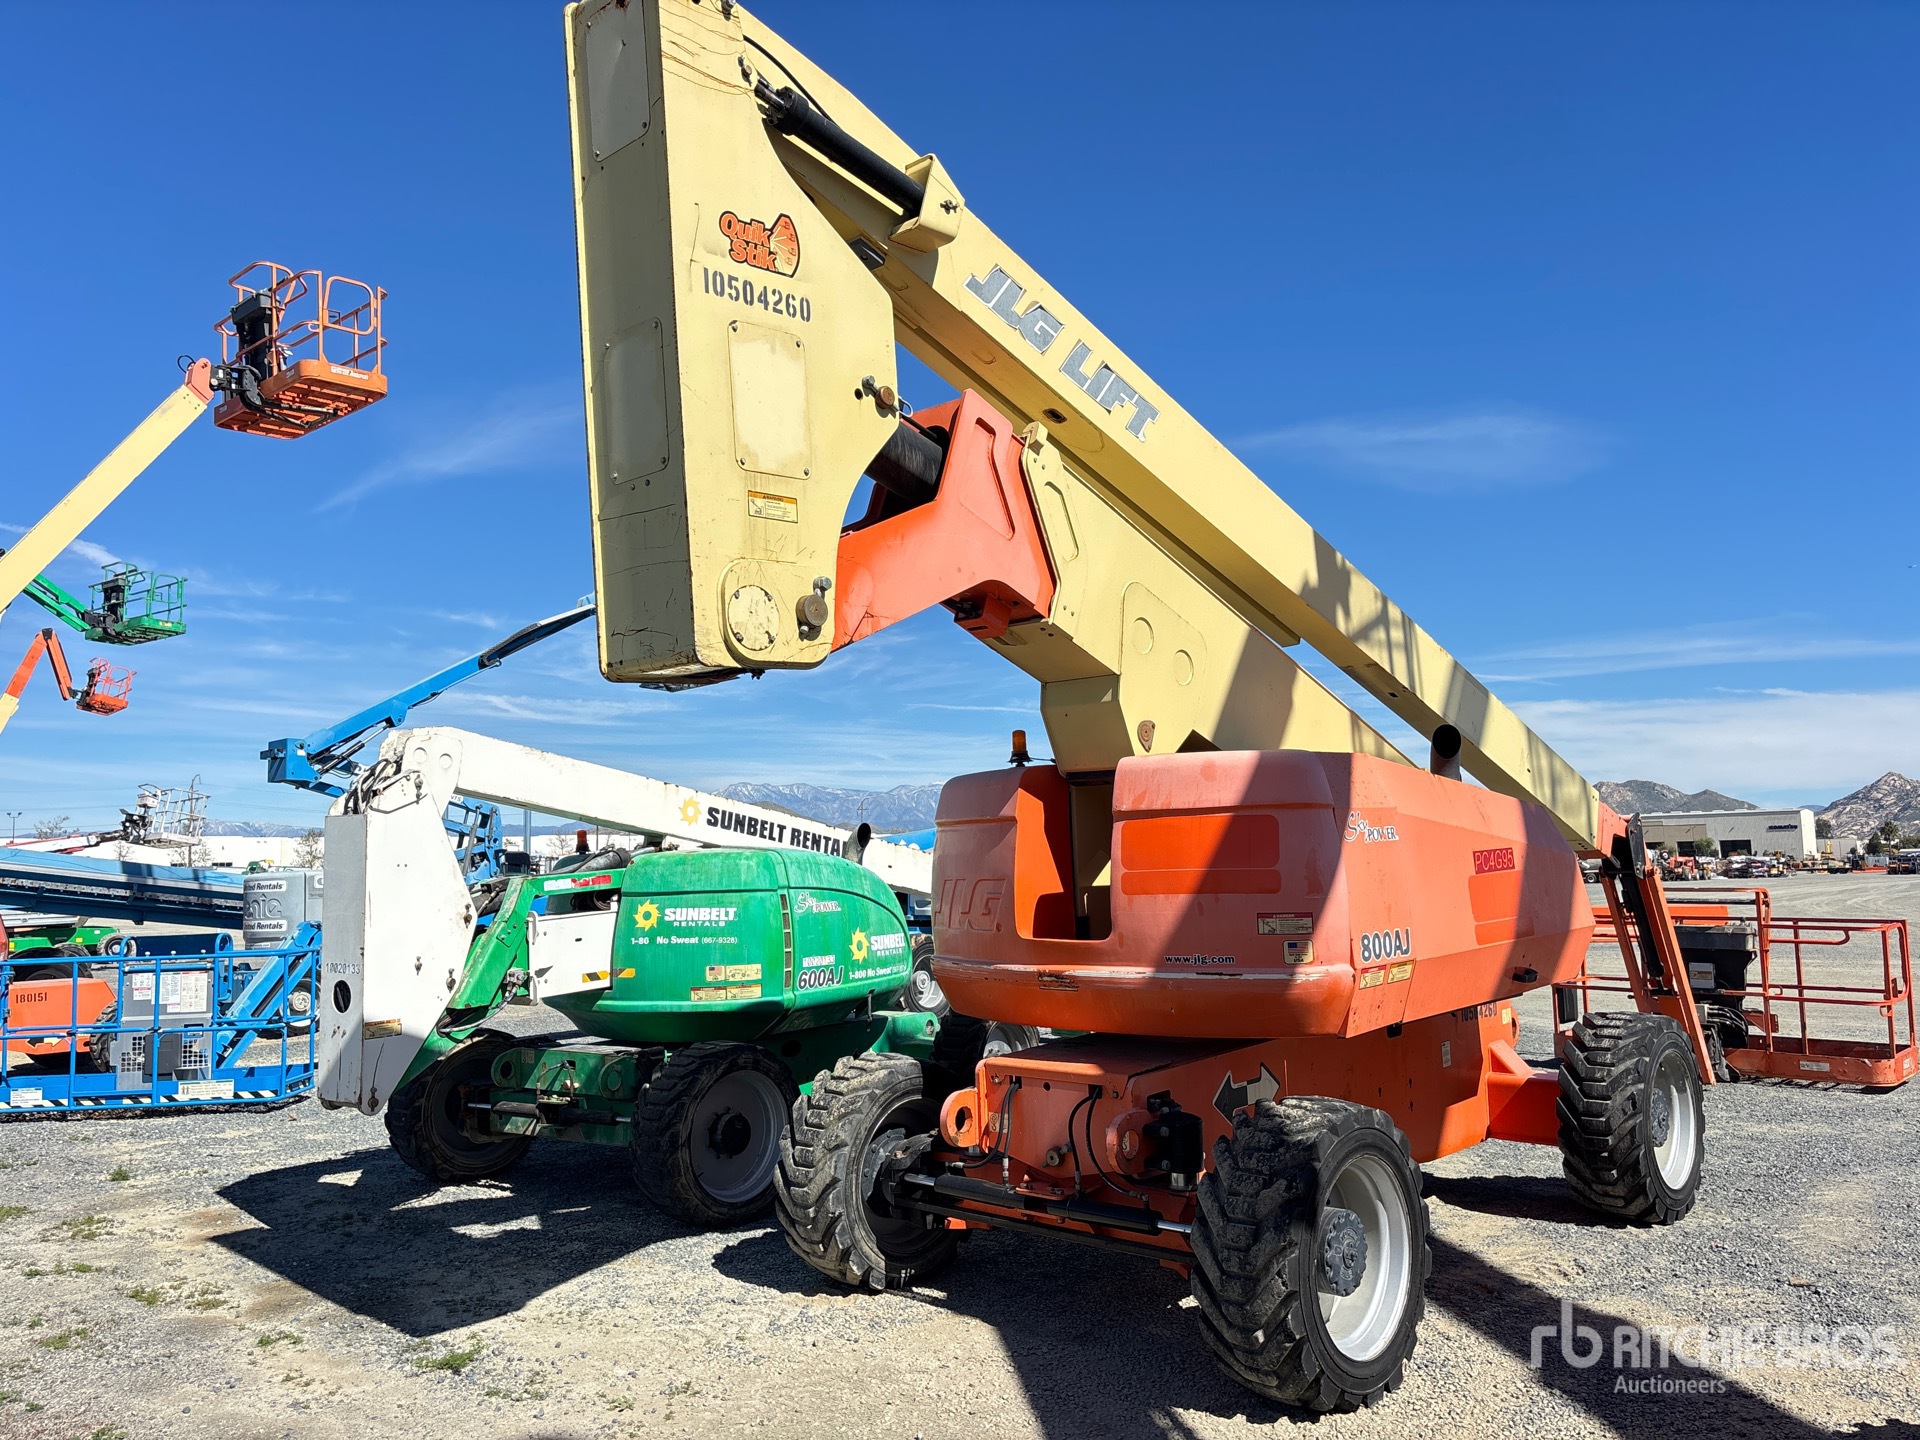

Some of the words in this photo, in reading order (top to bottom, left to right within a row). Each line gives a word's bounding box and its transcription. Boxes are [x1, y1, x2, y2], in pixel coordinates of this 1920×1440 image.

[719, 211, 771, 247] Quik
[729, 238, 777, 272] Stik
[703, 267, 811, 323] 10504260
[962, 264, 1066, 356] JLG
[1058, 339, 1161, 443] LIFT
[706, 806, 787, 843] SUNBELT
[789, 827, 850, 858] RENTA
[1474, 850, 1514, 872] PC4G95
[256, 882, 283, 891] Rentals
[813, 901, 841, 913] POWER
[934, 878, 1008, 932] JLG
[664, 907, 737, 921] SUNBELT
[256, 922, 283, 931] Rentals
[631, 937, 649, 945] 1-80
[656, 936, 669, 944] No
[670, 936, 699, 944] Sweat
[871, 933, 905, 951] SUNBELT
[1360, 927, 1411, 963] 800AJ
[877, 948, 902, 957] RENTALS
[1164, 954, 1235, 966] www.jlg.com
[325, 962, 361, 975] 10020133
[849, 970, 867, 980] 1-800
[797, 966, 844, 990] 600AJ
[15, 992, 47, 1004] 180151
